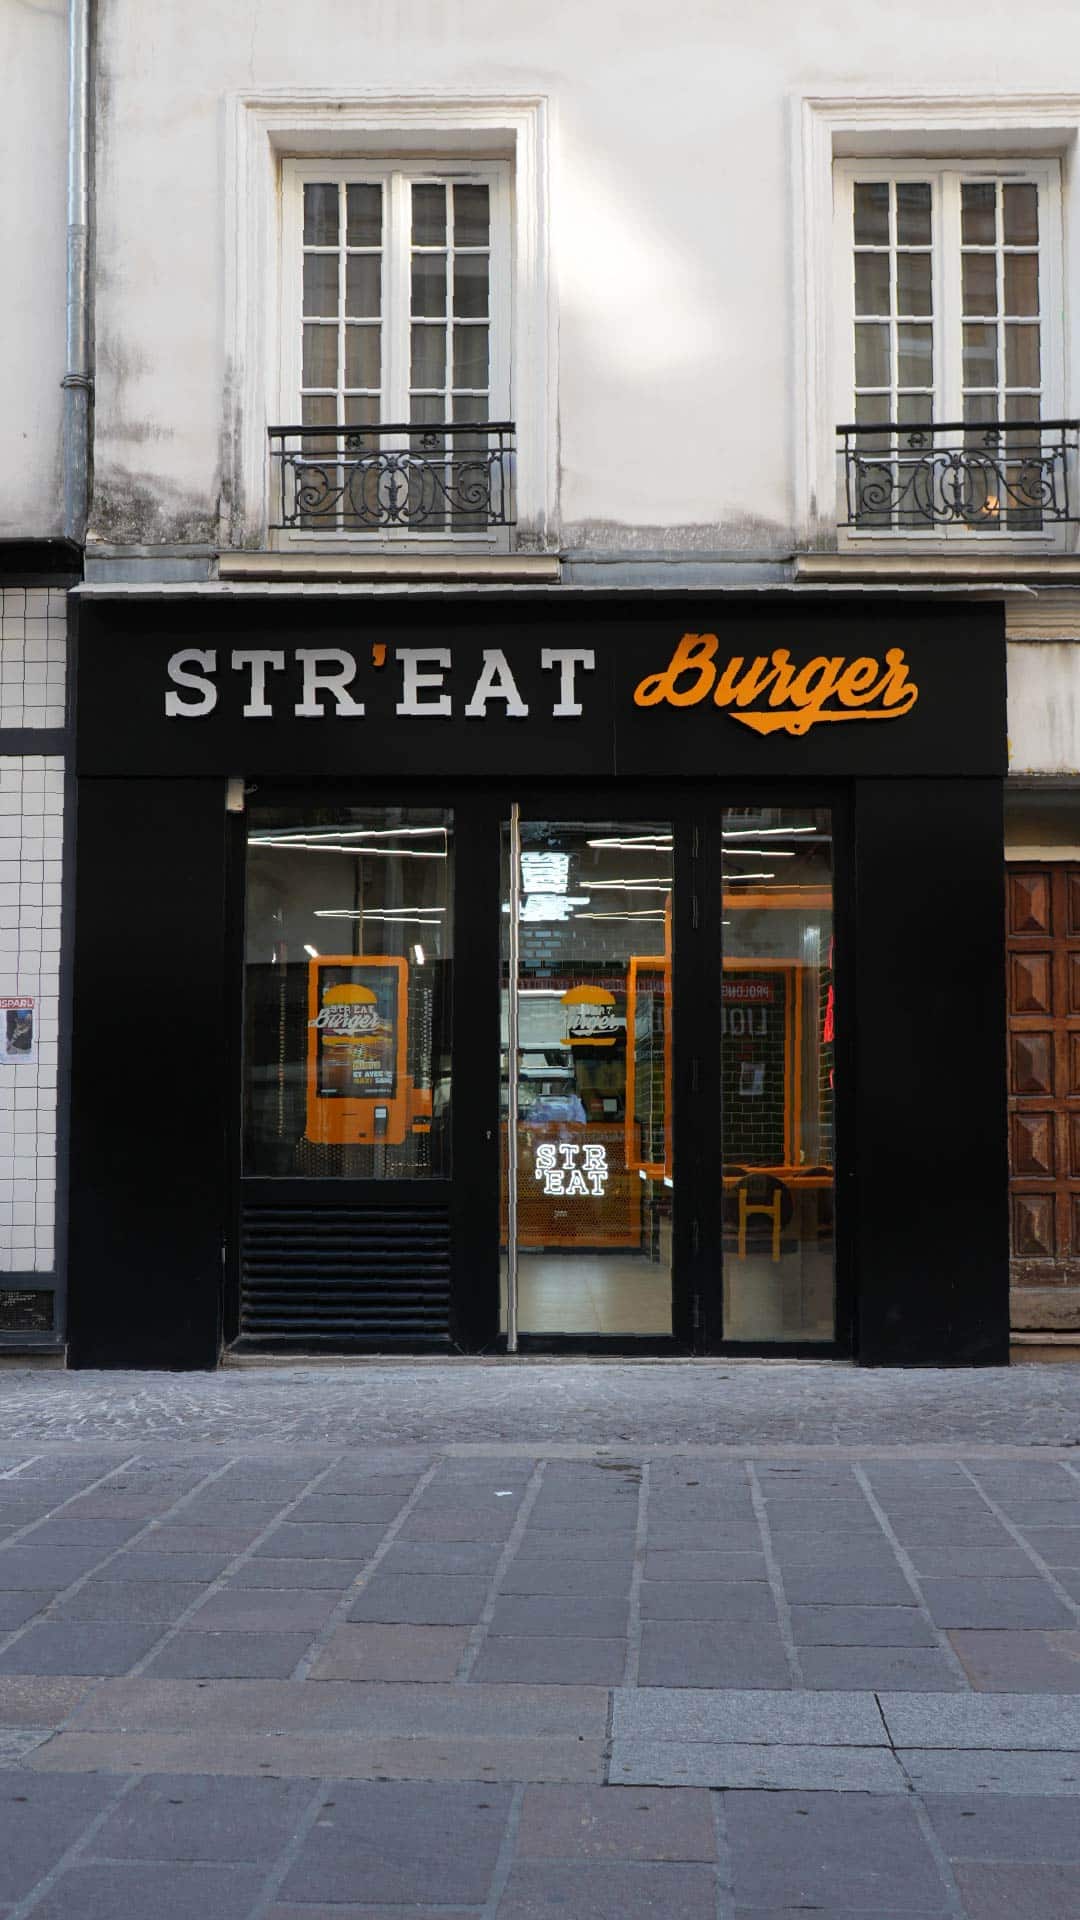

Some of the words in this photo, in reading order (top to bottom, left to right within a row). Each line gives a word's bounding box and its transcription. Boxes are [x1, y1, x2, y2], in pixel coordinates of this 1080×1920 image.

[164, 643, 596, 718] STR'EAT
[633, 633, 919, 736] Burger
[558, 1009, 620, 1037] urger
[536, 1144, 608, 1170] STR
